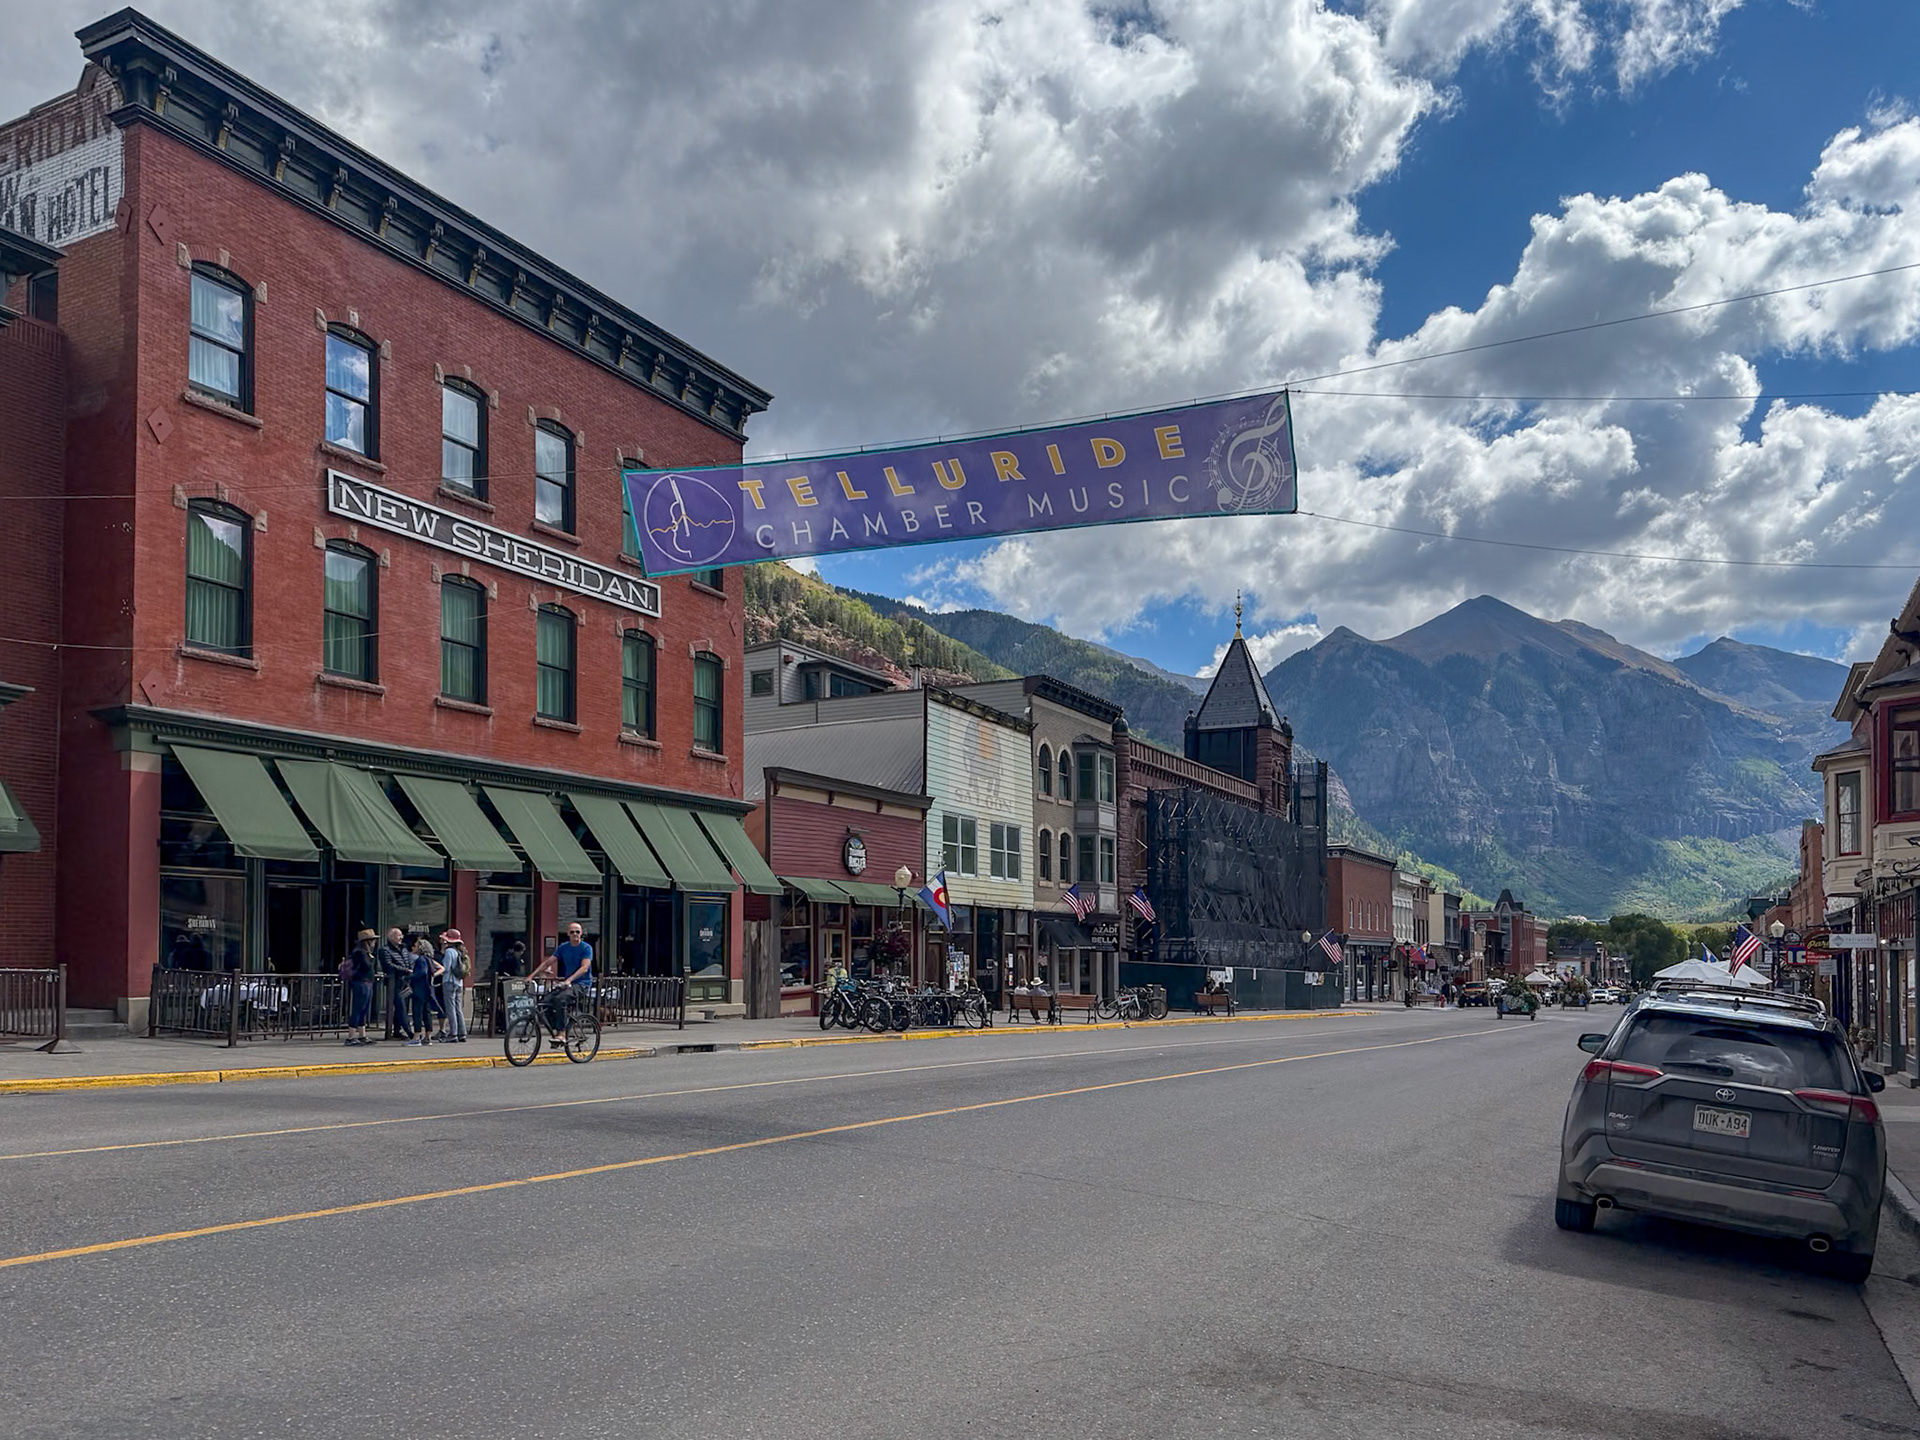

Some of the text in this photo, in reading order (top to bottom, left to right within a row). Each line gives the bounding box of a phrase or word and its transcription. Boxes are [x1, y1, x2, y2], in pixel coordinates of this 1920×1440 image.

[47, 166, 115, 243] HOTEL
[738, 425, 1186, 511] TELLURIDE
[339, 482, 440, 538] NEW
[756, 474, 1191, 551] CHAMBER MUSIC
[1091, 936, 1118, 944] BELLA
[1093, 926, 1117, 934] AZADI
